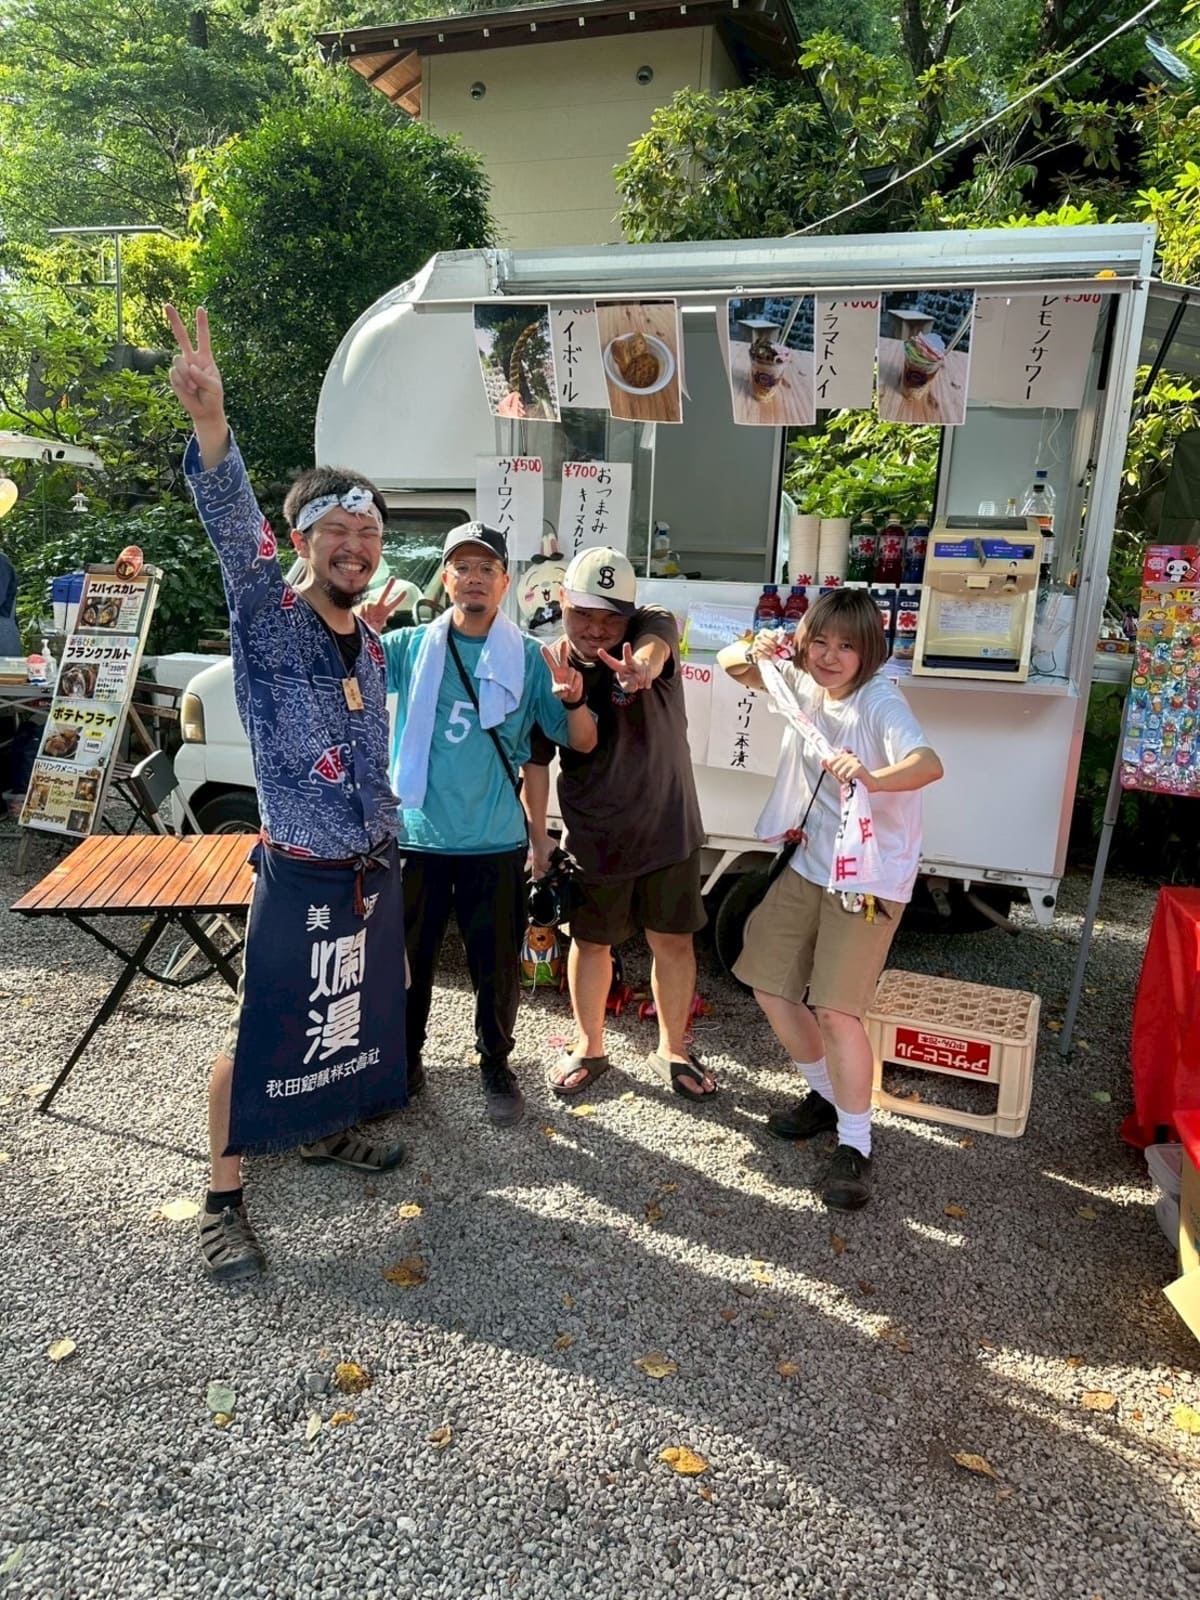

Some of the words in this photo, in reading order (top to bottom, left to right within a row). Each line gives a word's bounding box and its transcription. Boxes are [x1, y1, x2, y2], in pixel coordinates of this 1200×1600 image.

[1025, 295, 1060, 400] レモンサワー
[512, 458, 542, 473] ¥500
[564, 463, 597, 478] ¥700
[498, 459, 515, 543] ウーロンハイ
[591, 468, 614, 534] おつまみ
[464, 521, 483, 538] LA
[89, 583, 145, 595] スパイスカレー
[66, 647, 132, 660] フランクフルト
[53, 707, 117, 727] ポテトフライ
[444, 701, 475, 744] 5
[731, 685, 757, 769] ュウリ一本漬
[305, 903, 331, 932] 美
[896, 1042, 988, 1073] アサヒビール
